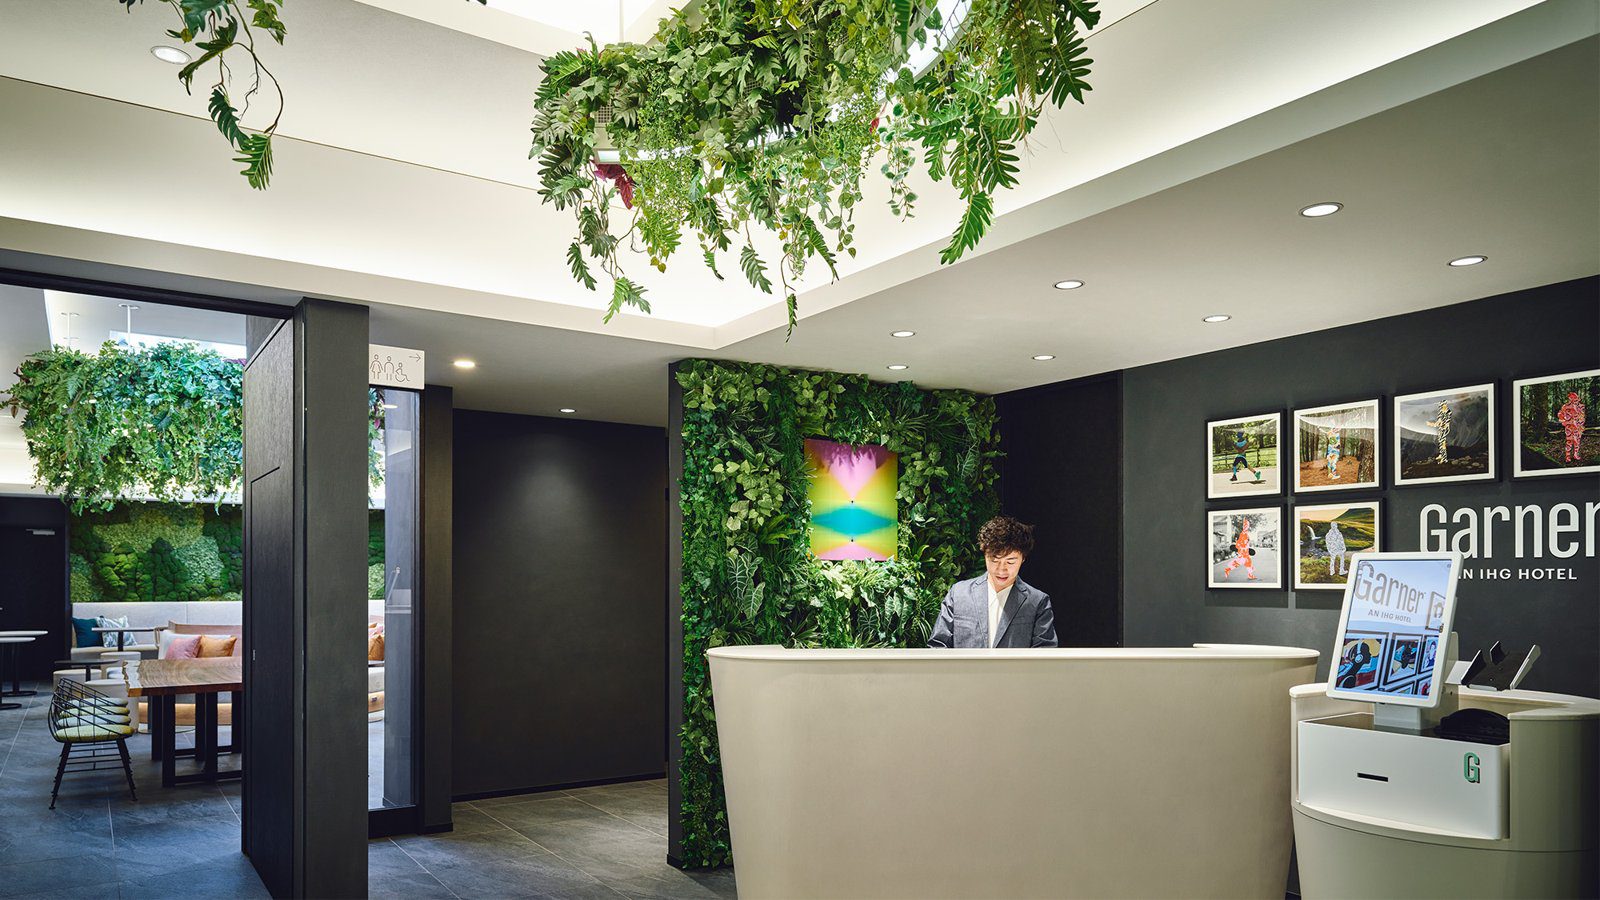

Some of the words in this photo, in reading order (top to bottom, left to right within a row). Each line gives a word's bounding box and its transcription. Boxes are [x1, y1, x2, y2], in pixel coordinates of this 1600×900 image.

[1458, 569, 1473, 579] N
[1480, 569, 1511, 579] IHG
[1519, 569, 1577, 579] HOTEL
[1355, 562, 1424, 613] Garner
[1368, 609, 1379, 617] AN
[1381, 611, 1394, 619] IHG
[1395, 615, 1412, 623] HOTEL
[1464, 752, 1480, 783] G
